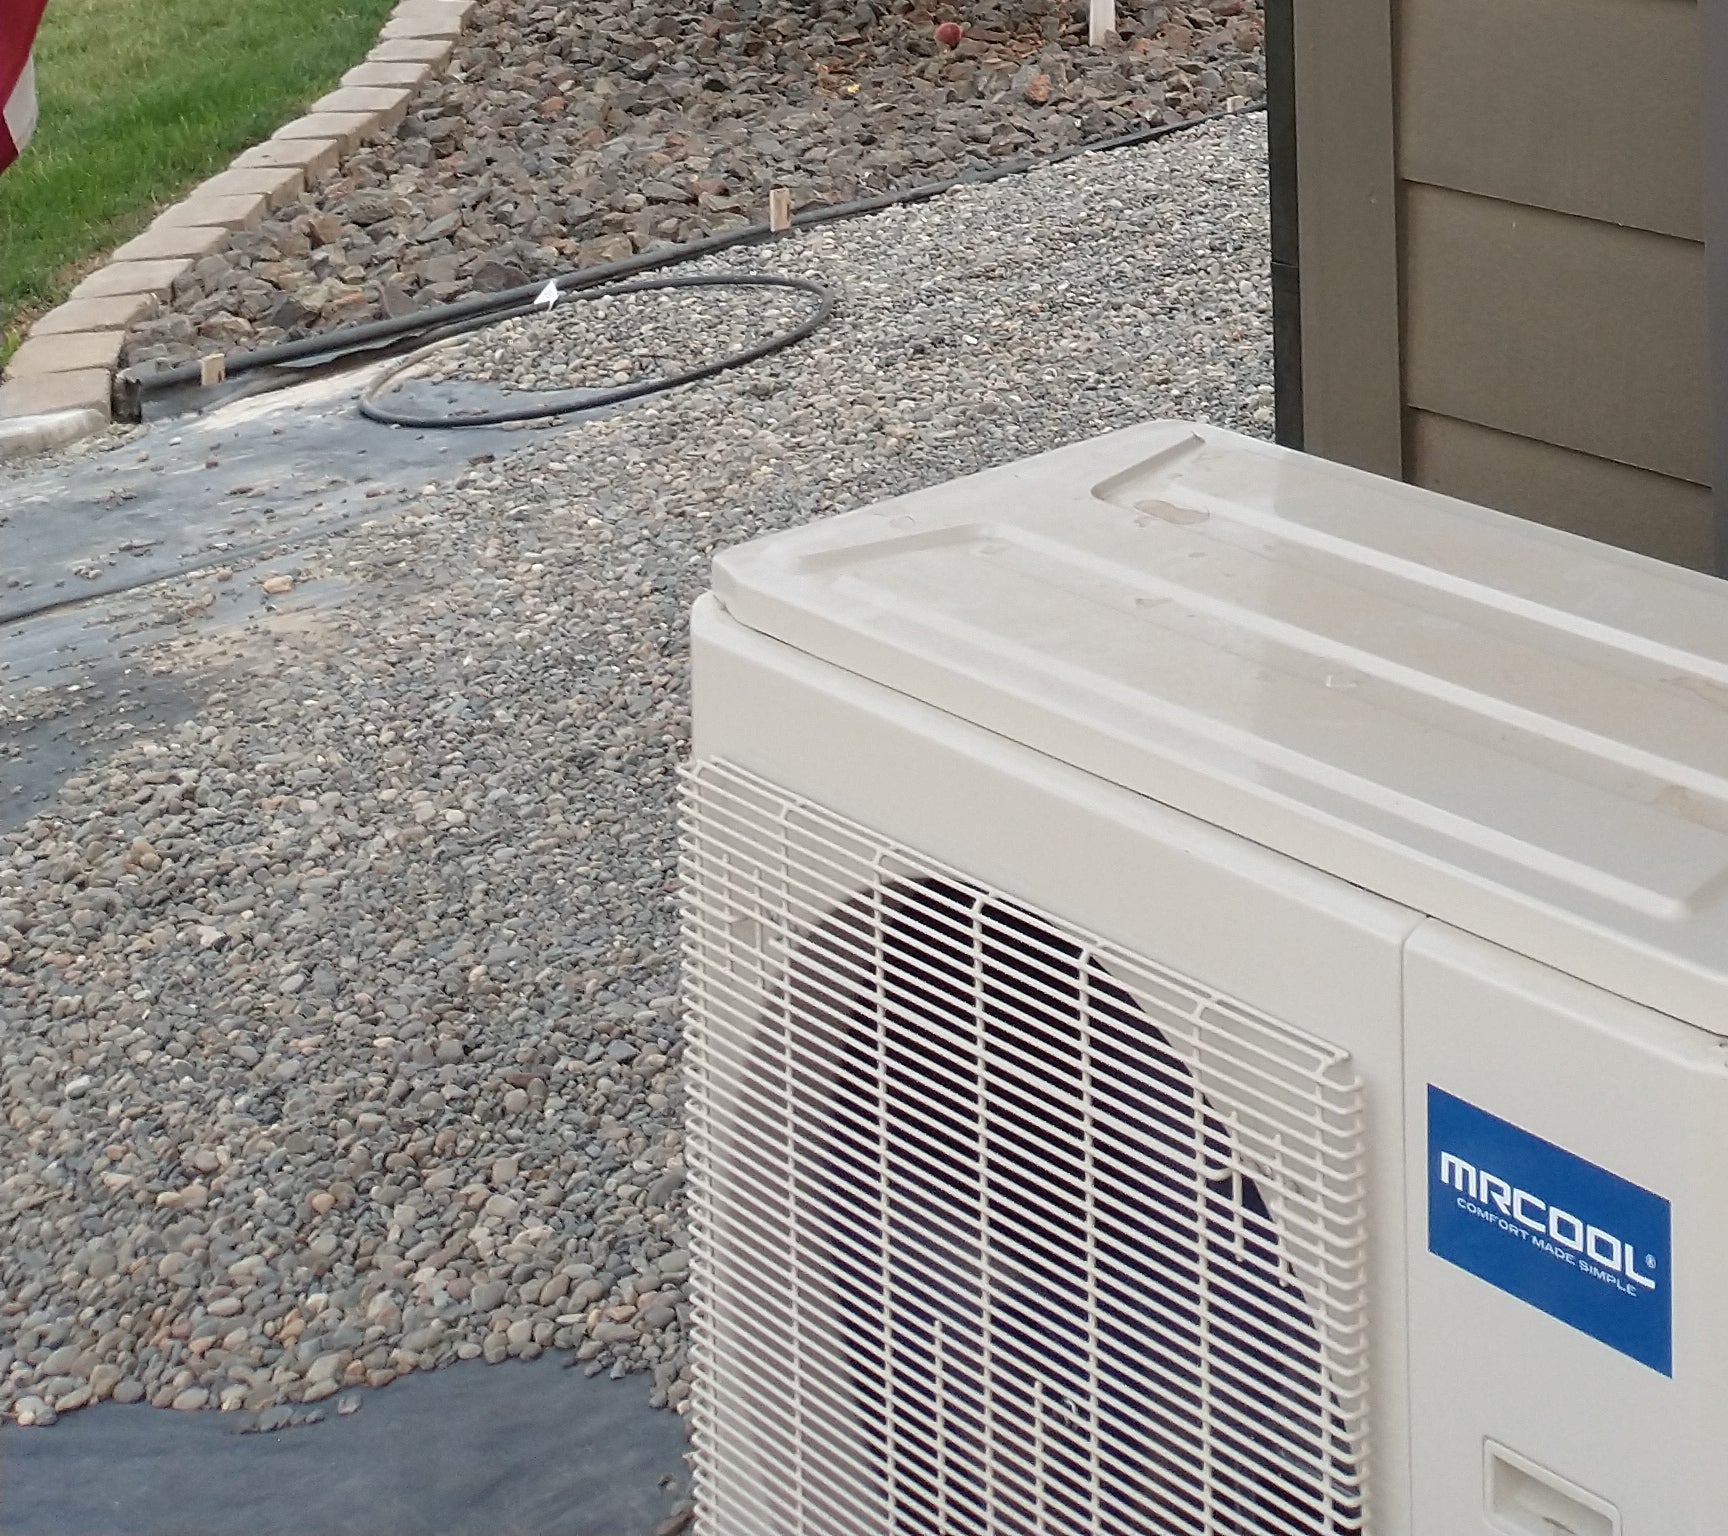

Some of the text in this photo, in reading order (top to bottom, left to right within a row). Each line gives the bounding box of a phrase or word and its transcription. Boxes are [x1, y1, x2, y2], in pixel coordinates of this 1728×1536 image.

[1457, 1197, 1637, 1297] COMFORT MADE SIMPLE
